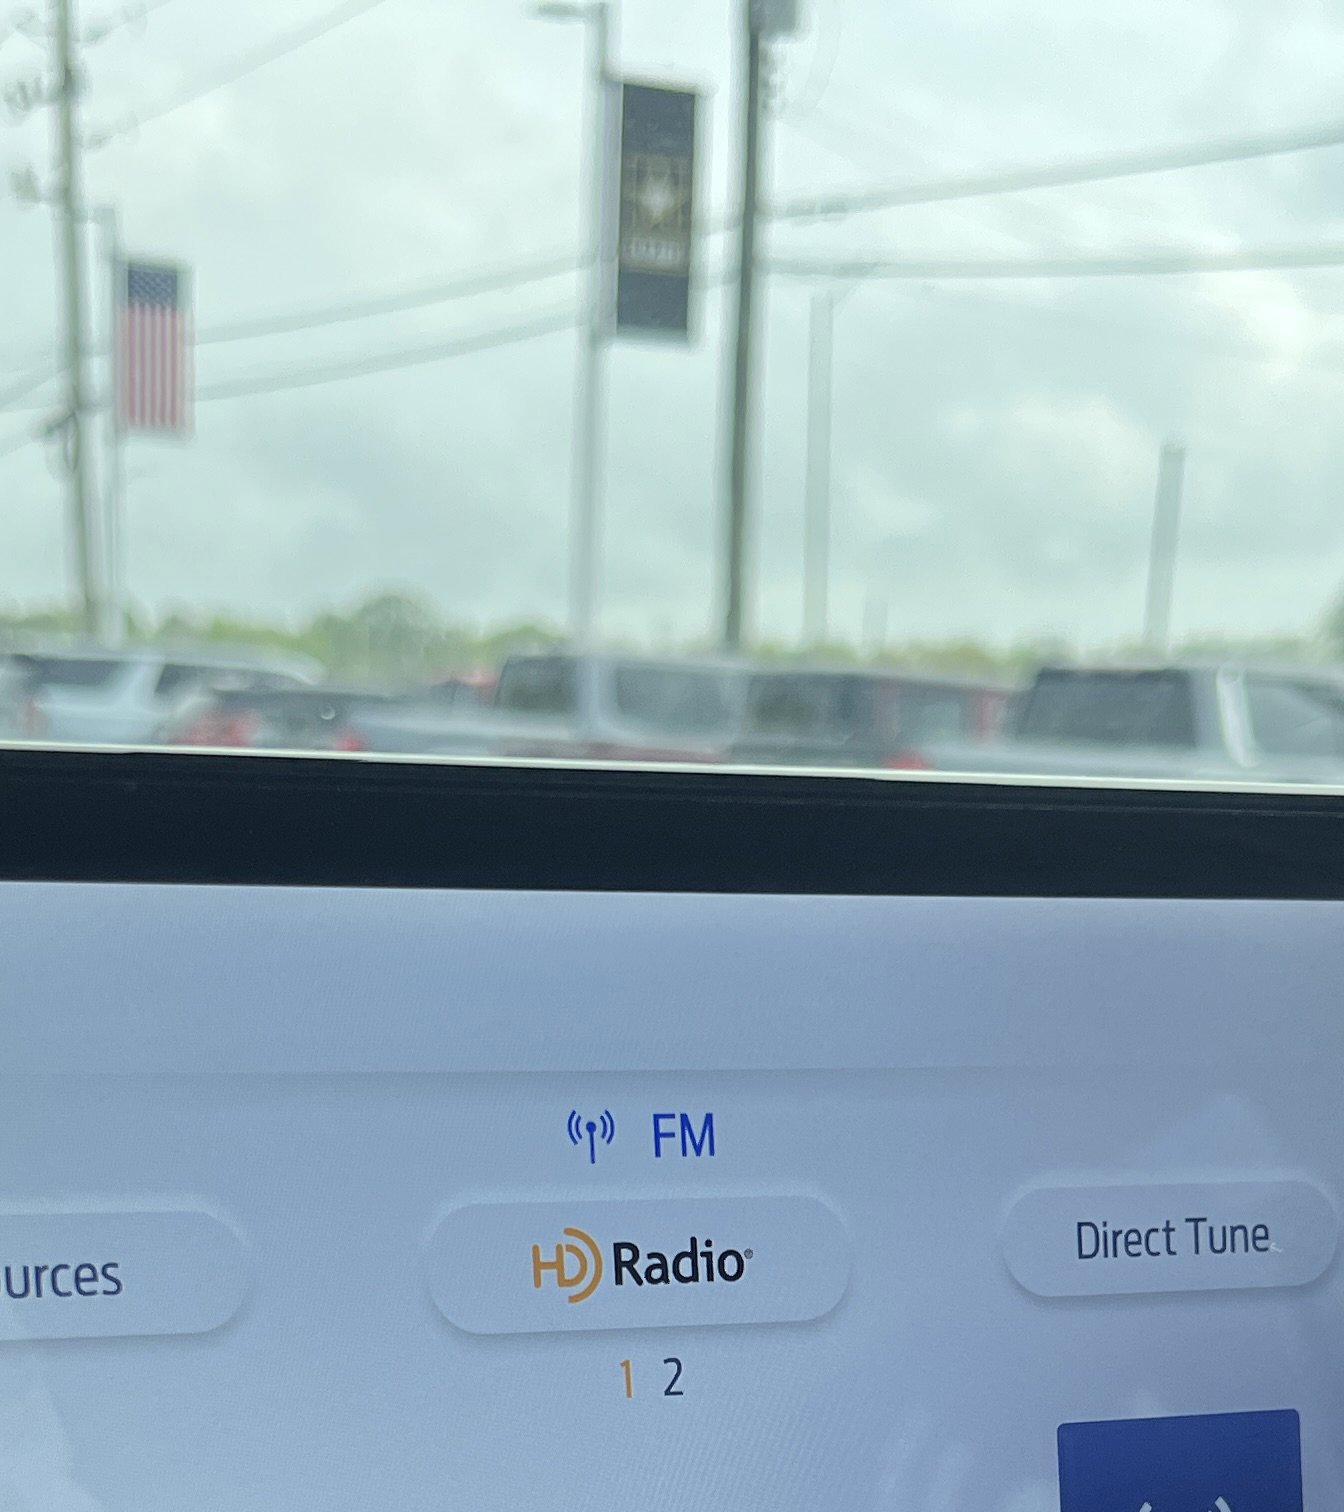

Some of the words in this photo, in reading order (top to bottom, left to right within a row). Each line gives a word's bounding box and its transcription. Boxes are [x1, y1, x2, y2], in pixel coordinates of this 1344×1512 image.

[652, 1112, 716, 1159] FM
[1076, 1219, 1178, 1260] Direct
[1184, 1216, 1271, 1256] Tune
[531, 1226, 604, 1305] HD
[619, 1358, 634, 1399] 1
[662, 1356, 685, 1397] 2
